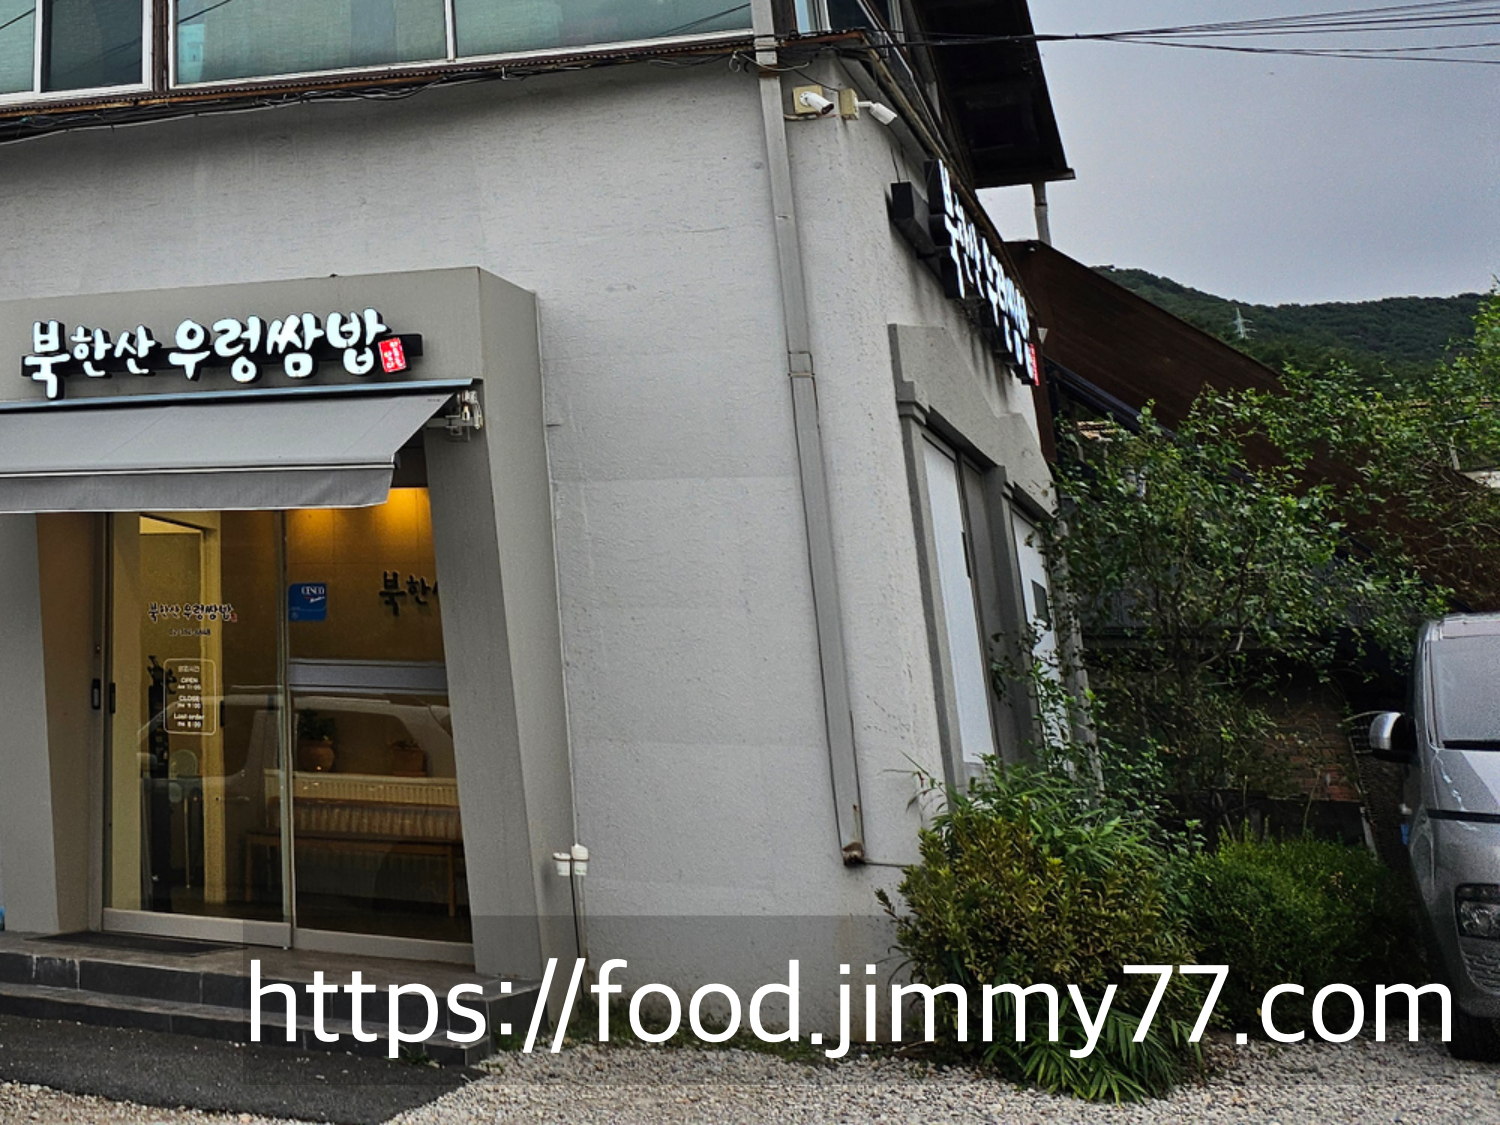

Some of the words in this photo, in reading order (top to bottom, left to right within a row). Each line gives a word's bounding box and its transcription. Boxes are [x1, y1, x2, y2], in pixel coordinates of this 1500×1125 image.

[25, 320, 156, 399] 북한산
[168, 308, 387, 383] 우렁쌈밥
[379, 571, 439, 616] 북한
